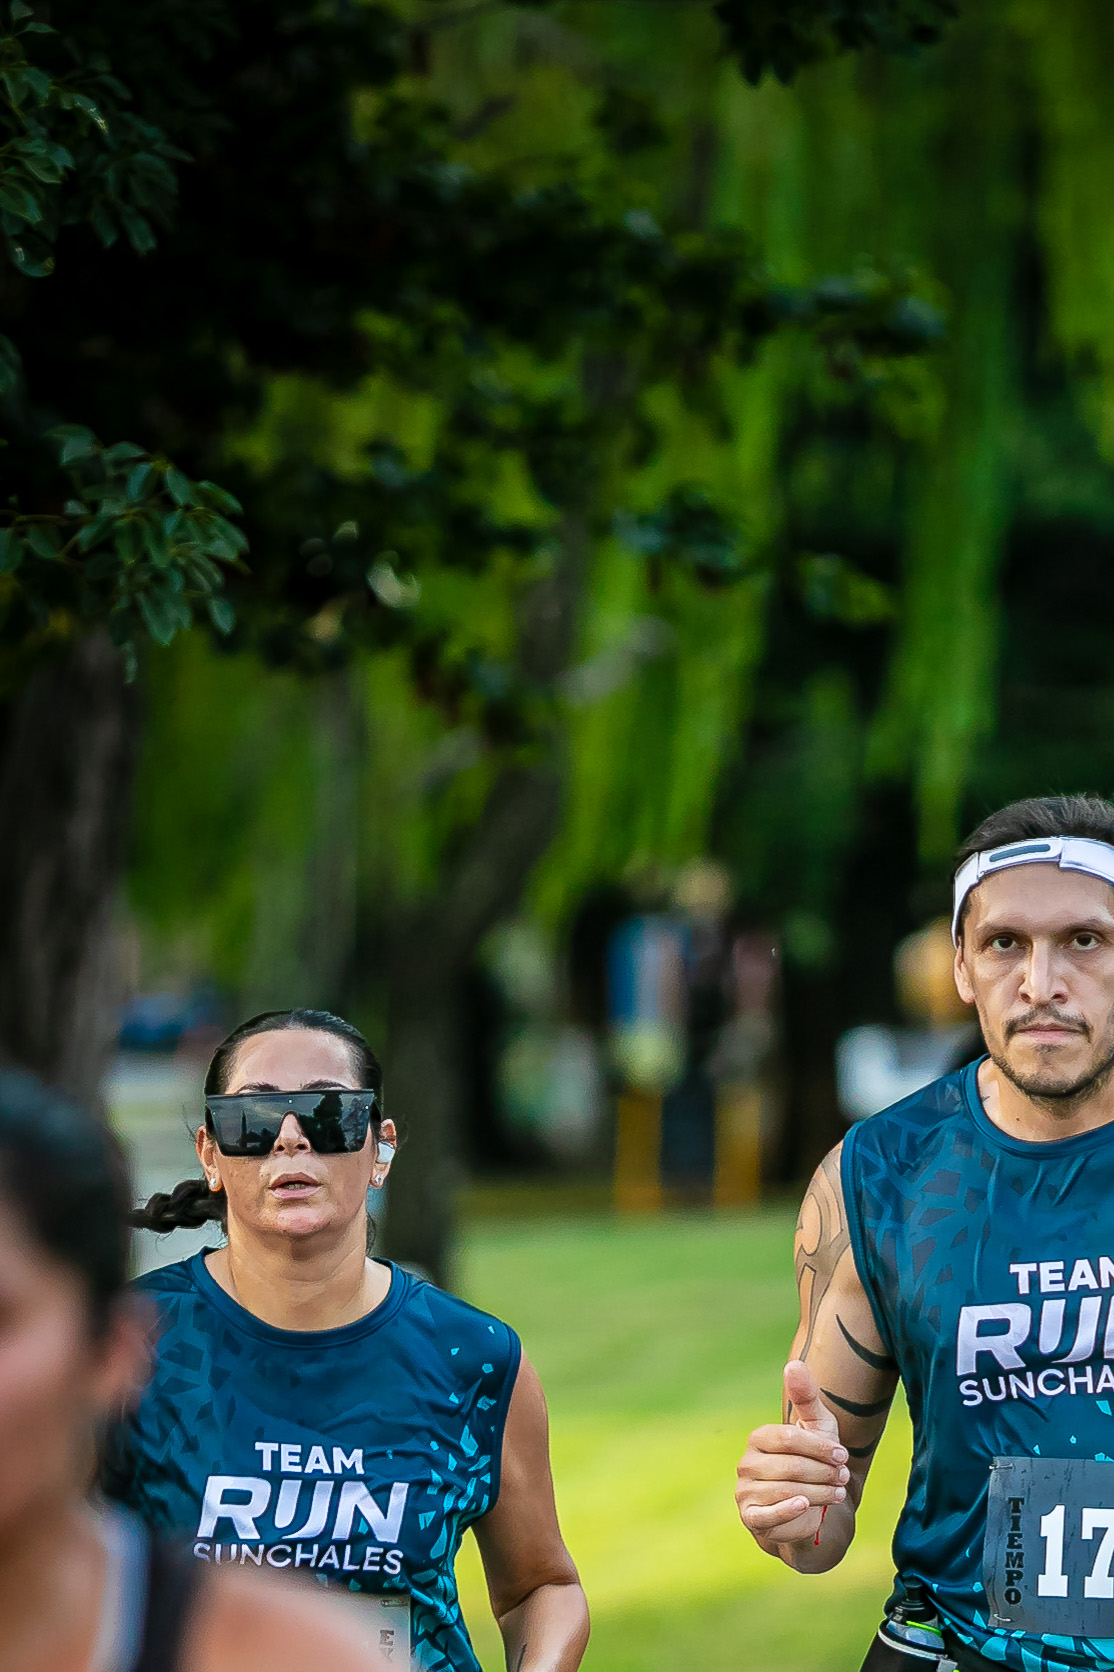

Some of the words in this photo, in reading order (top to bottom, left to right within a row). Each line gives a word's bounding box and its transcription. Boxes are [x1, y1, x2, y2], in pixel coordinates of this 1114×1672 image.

[255, 1442, 365, 1475] TEAM
[197, 1475, 409, 1543] RUN
[193, 1542, 404, 1575] SUNCHALES
[1004, 1497, 1025, 1605] TIEMPO
